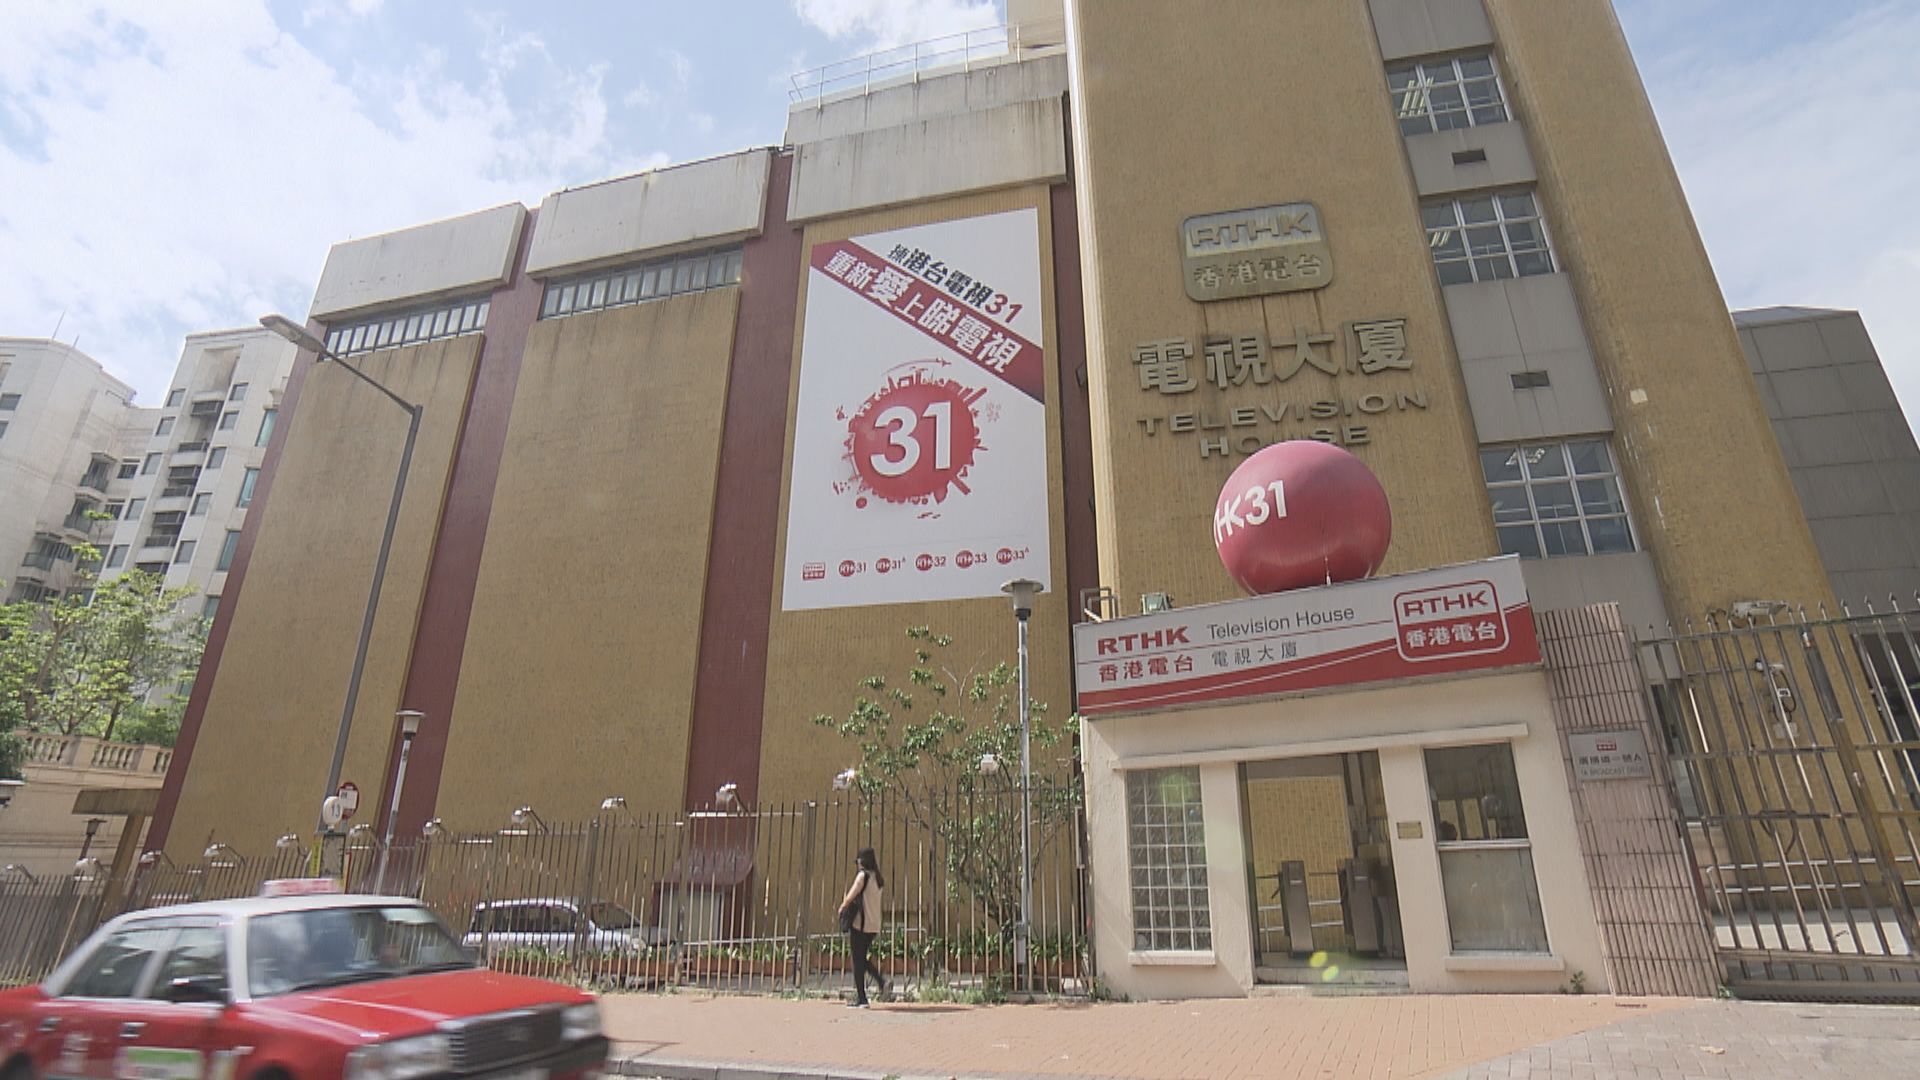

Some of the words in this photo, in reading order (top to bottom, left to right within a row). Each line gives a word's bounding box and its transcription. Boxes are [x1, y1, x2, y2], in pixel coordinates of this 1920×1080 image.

[1190, 212, 1312, 247] RTHK
[1193, 254, 1322, 288] 香港電台
[824, 250, 1022, 373] 重新愛上睇電視
[1137, 389, 1428, 436] TELEVISION
[870, 401, 951, 477] 31
[1198, 425, 1371, 458] HOSE
[1403, 590, 1488, 617] RTHK
[1097, 626, 1190, 655] RTHK
[1207, 614, 1290, 640] Television
[1295, 607, 1354, 628] House
[1406, 621, 1497, 648] 香港電台
[1099, 654, 1194, 683] 香港電台
